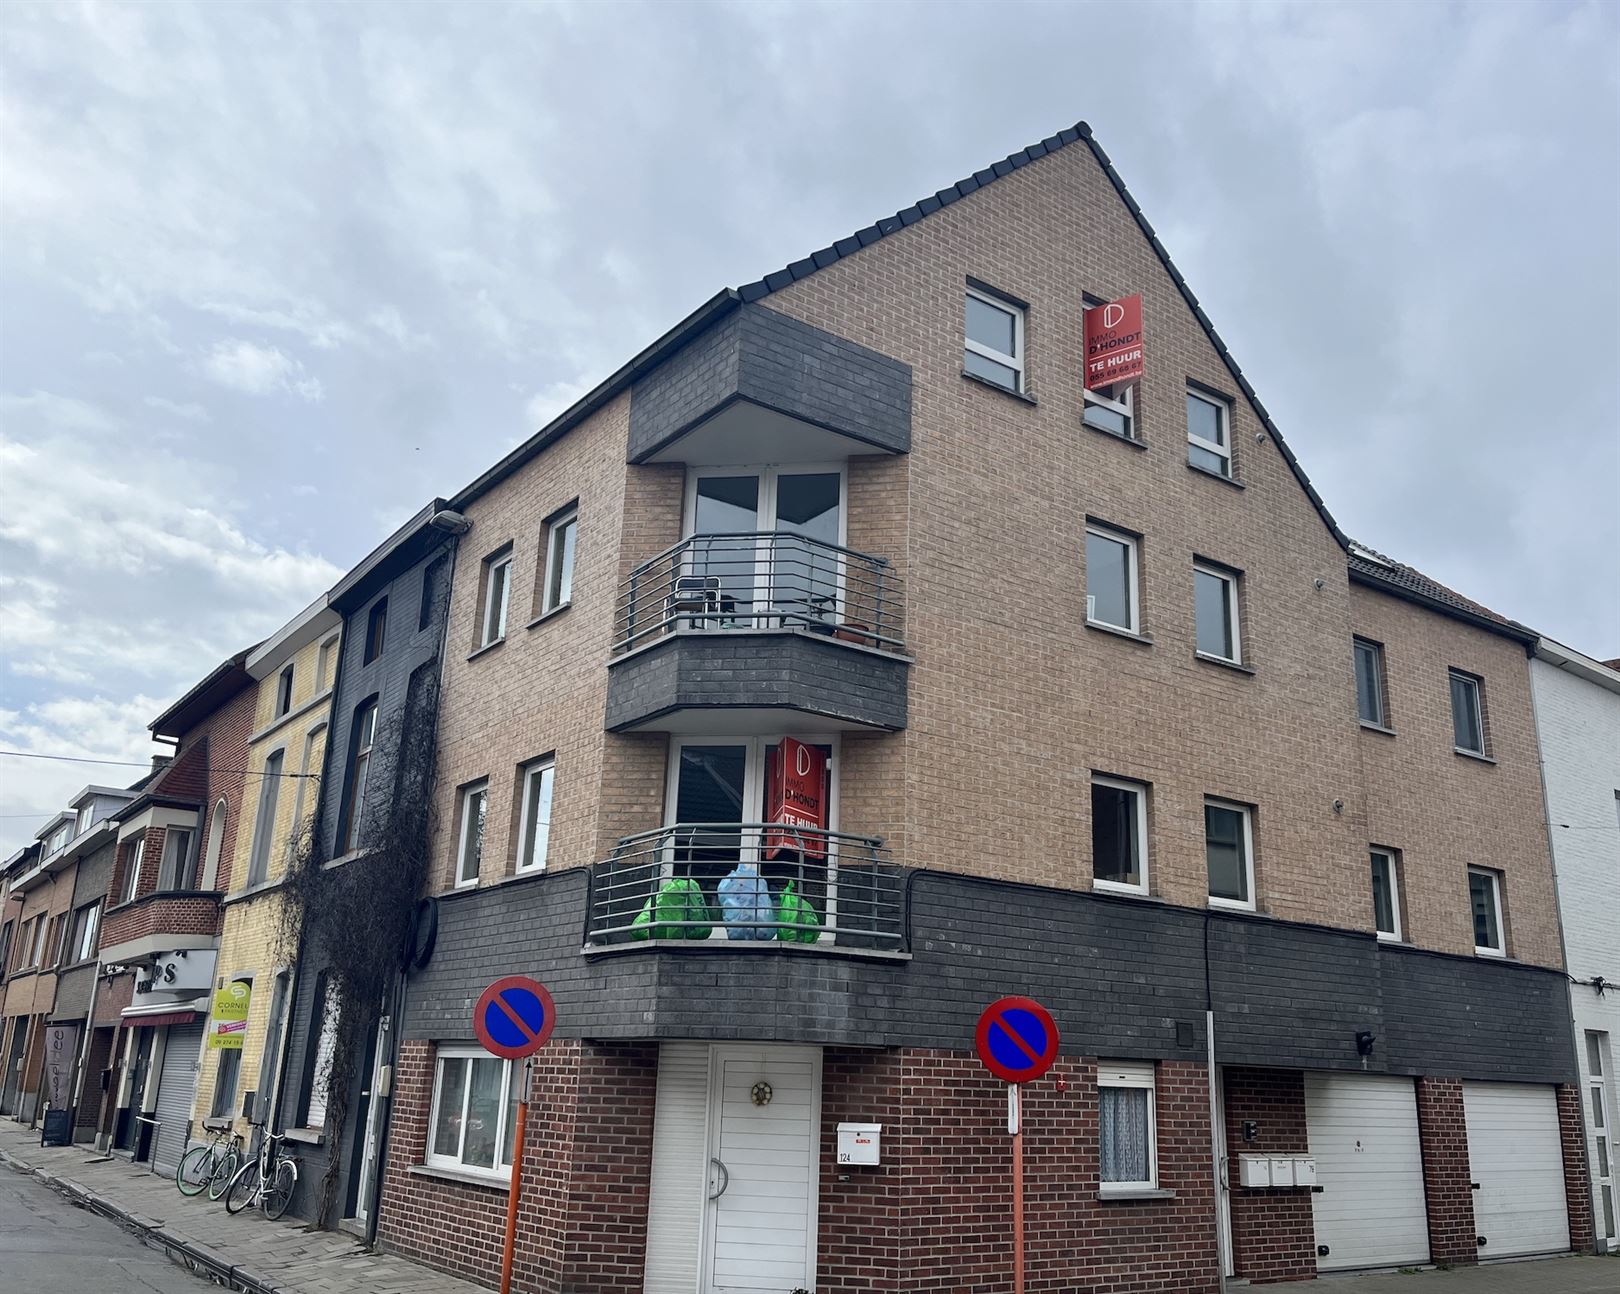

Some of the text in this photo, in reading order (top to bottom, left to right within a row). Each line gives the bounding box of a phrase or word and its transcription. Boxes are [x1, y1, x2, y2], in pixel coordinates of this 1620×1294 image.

[1089, 330, 1117, 346] IMMO
[1089, 332, 1141, 355] D'HONDT
[1090, 350, 1141, 372] TE HUUR
[1090, 373, 1105, 383] 055
[785, 788, 819, 810] D'HONDT
[785, 813, 795, 825] TE
[840, 1153, 850, 1162] 124
